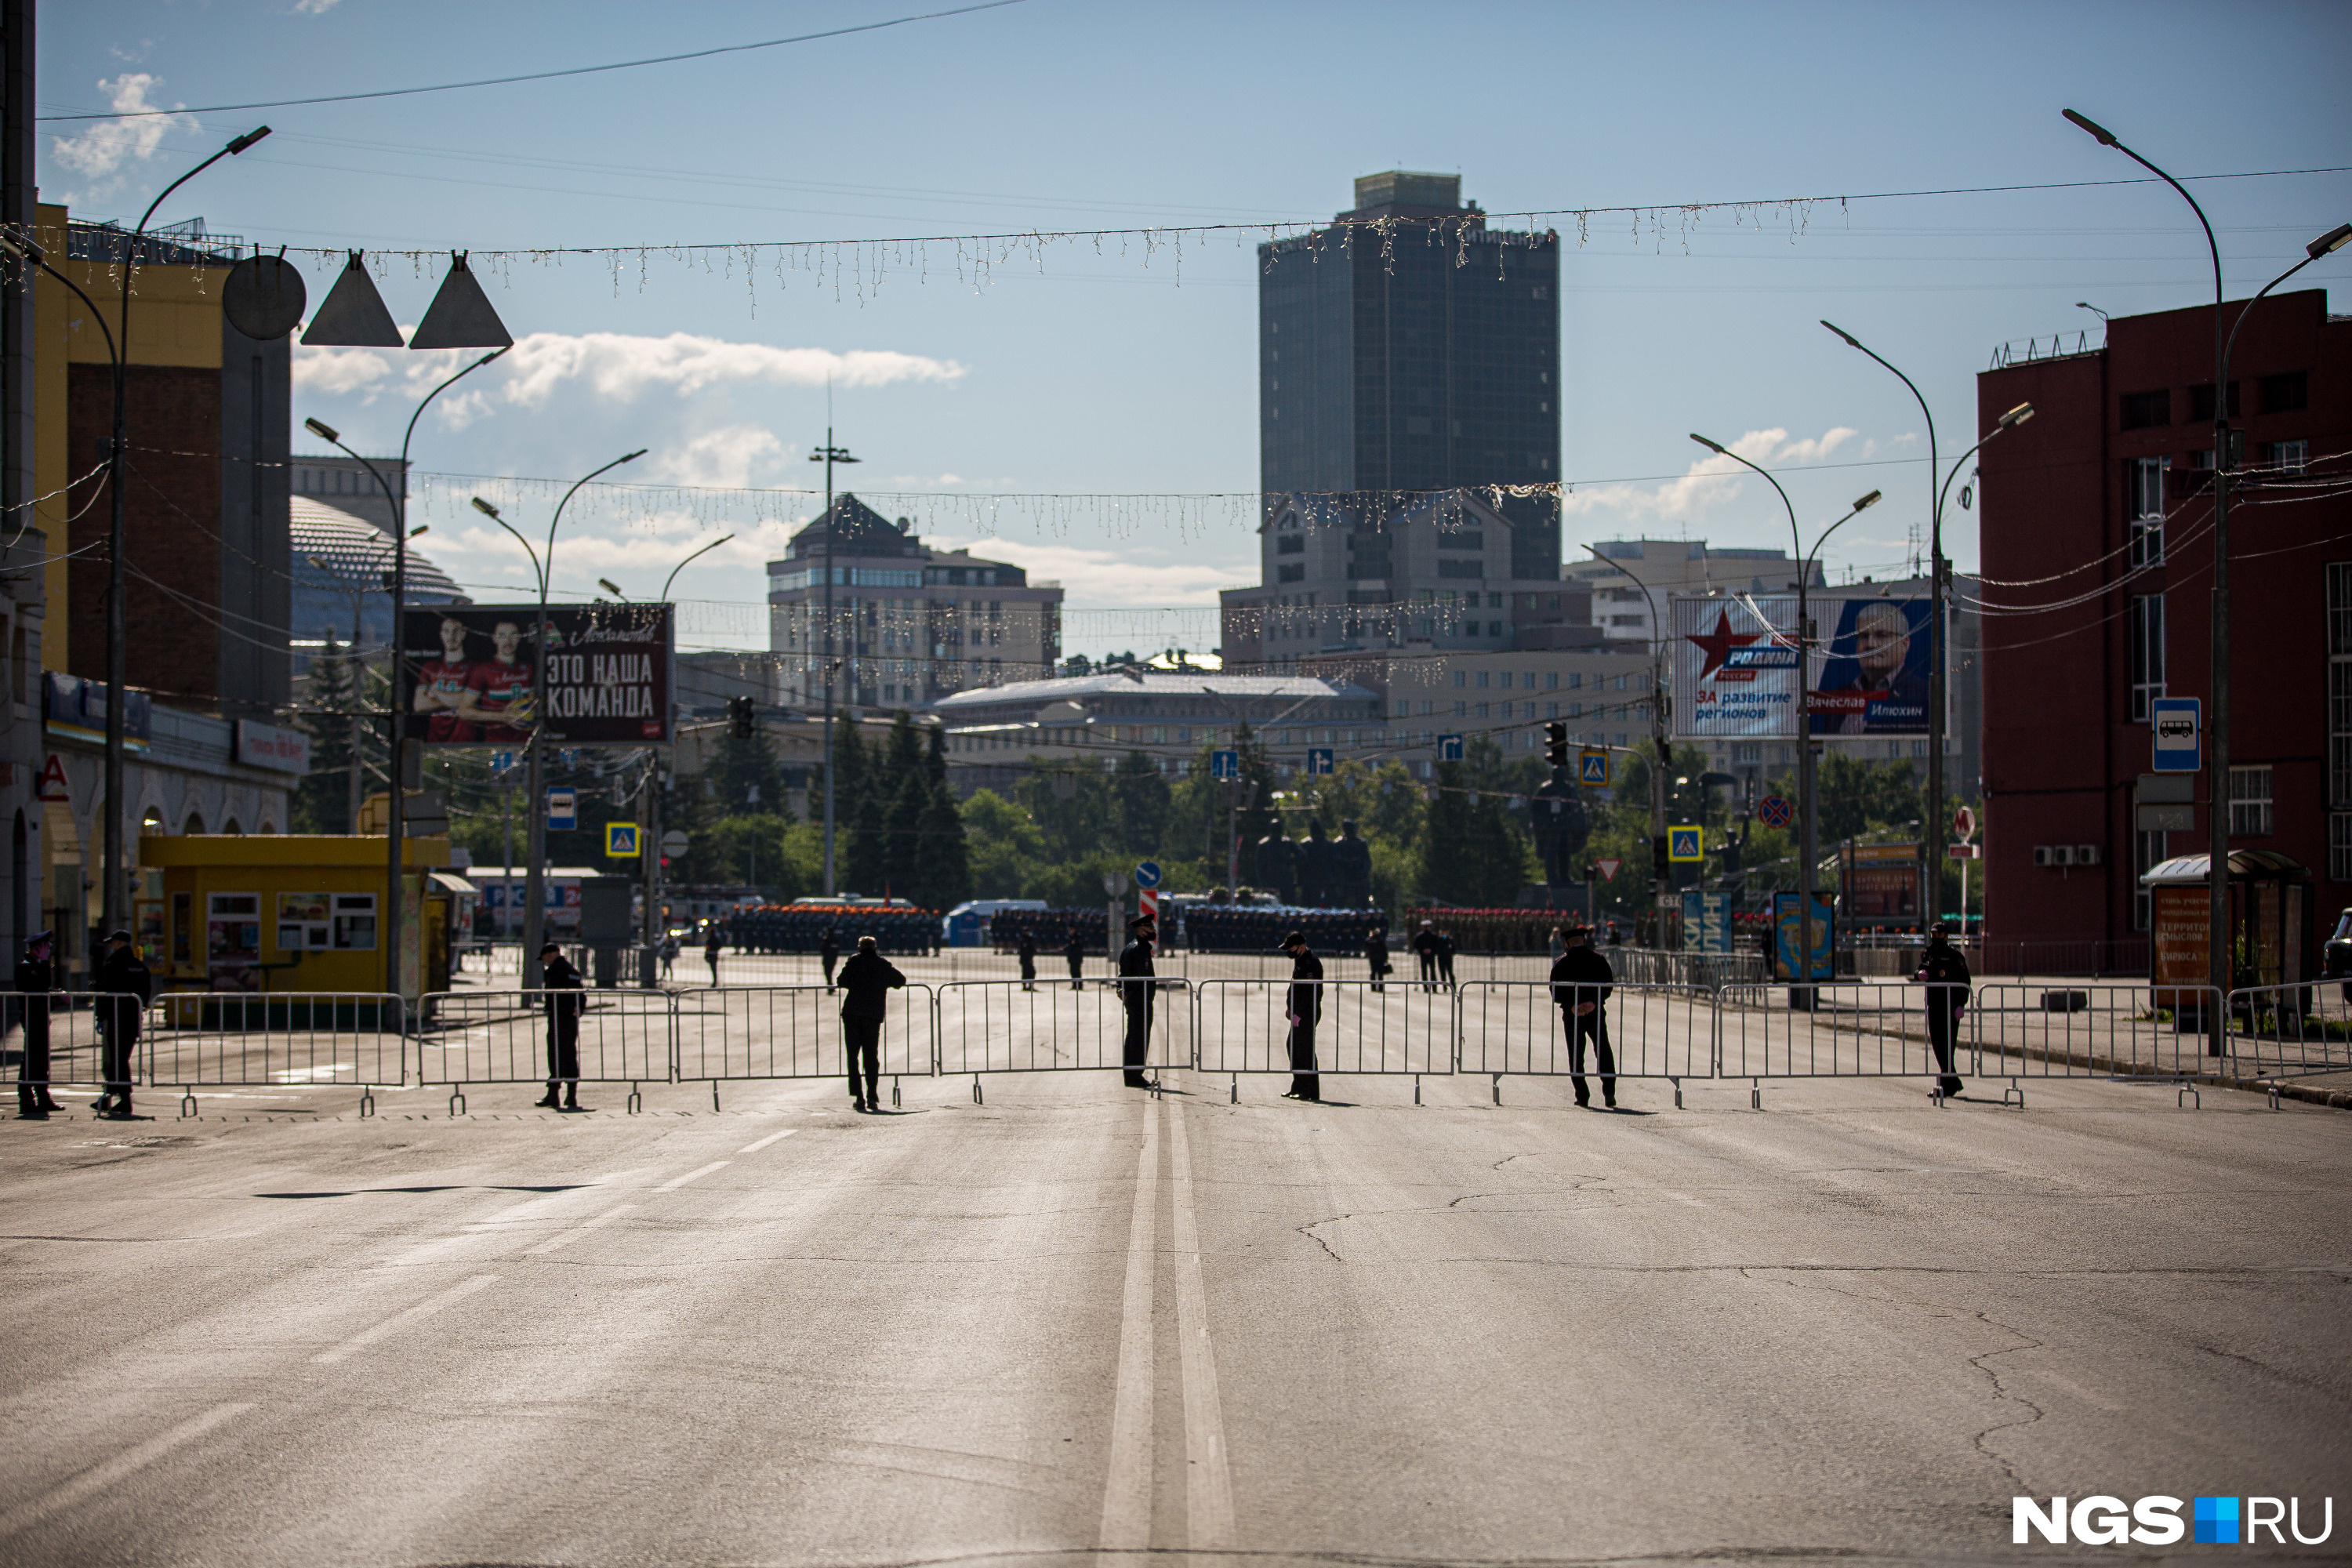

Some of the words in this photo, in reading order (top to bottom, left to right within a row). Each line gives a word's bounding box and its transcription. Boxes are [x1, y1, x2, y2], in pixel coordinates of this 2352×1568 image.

[1729, 648, 1797, 666] РОДИНА
[546, 654, 584, 684] ЭТО
[593, 654, 652, 684] НАША
[547, 687, 653, 717] КОМАНДА
[1696, 691, 1717, 703] ЗА
[1722, 691, 1791, 706] развитие
[1696, 709, 1766, 722] регионов
[1871, 703, 1923, 717] Илюхин
